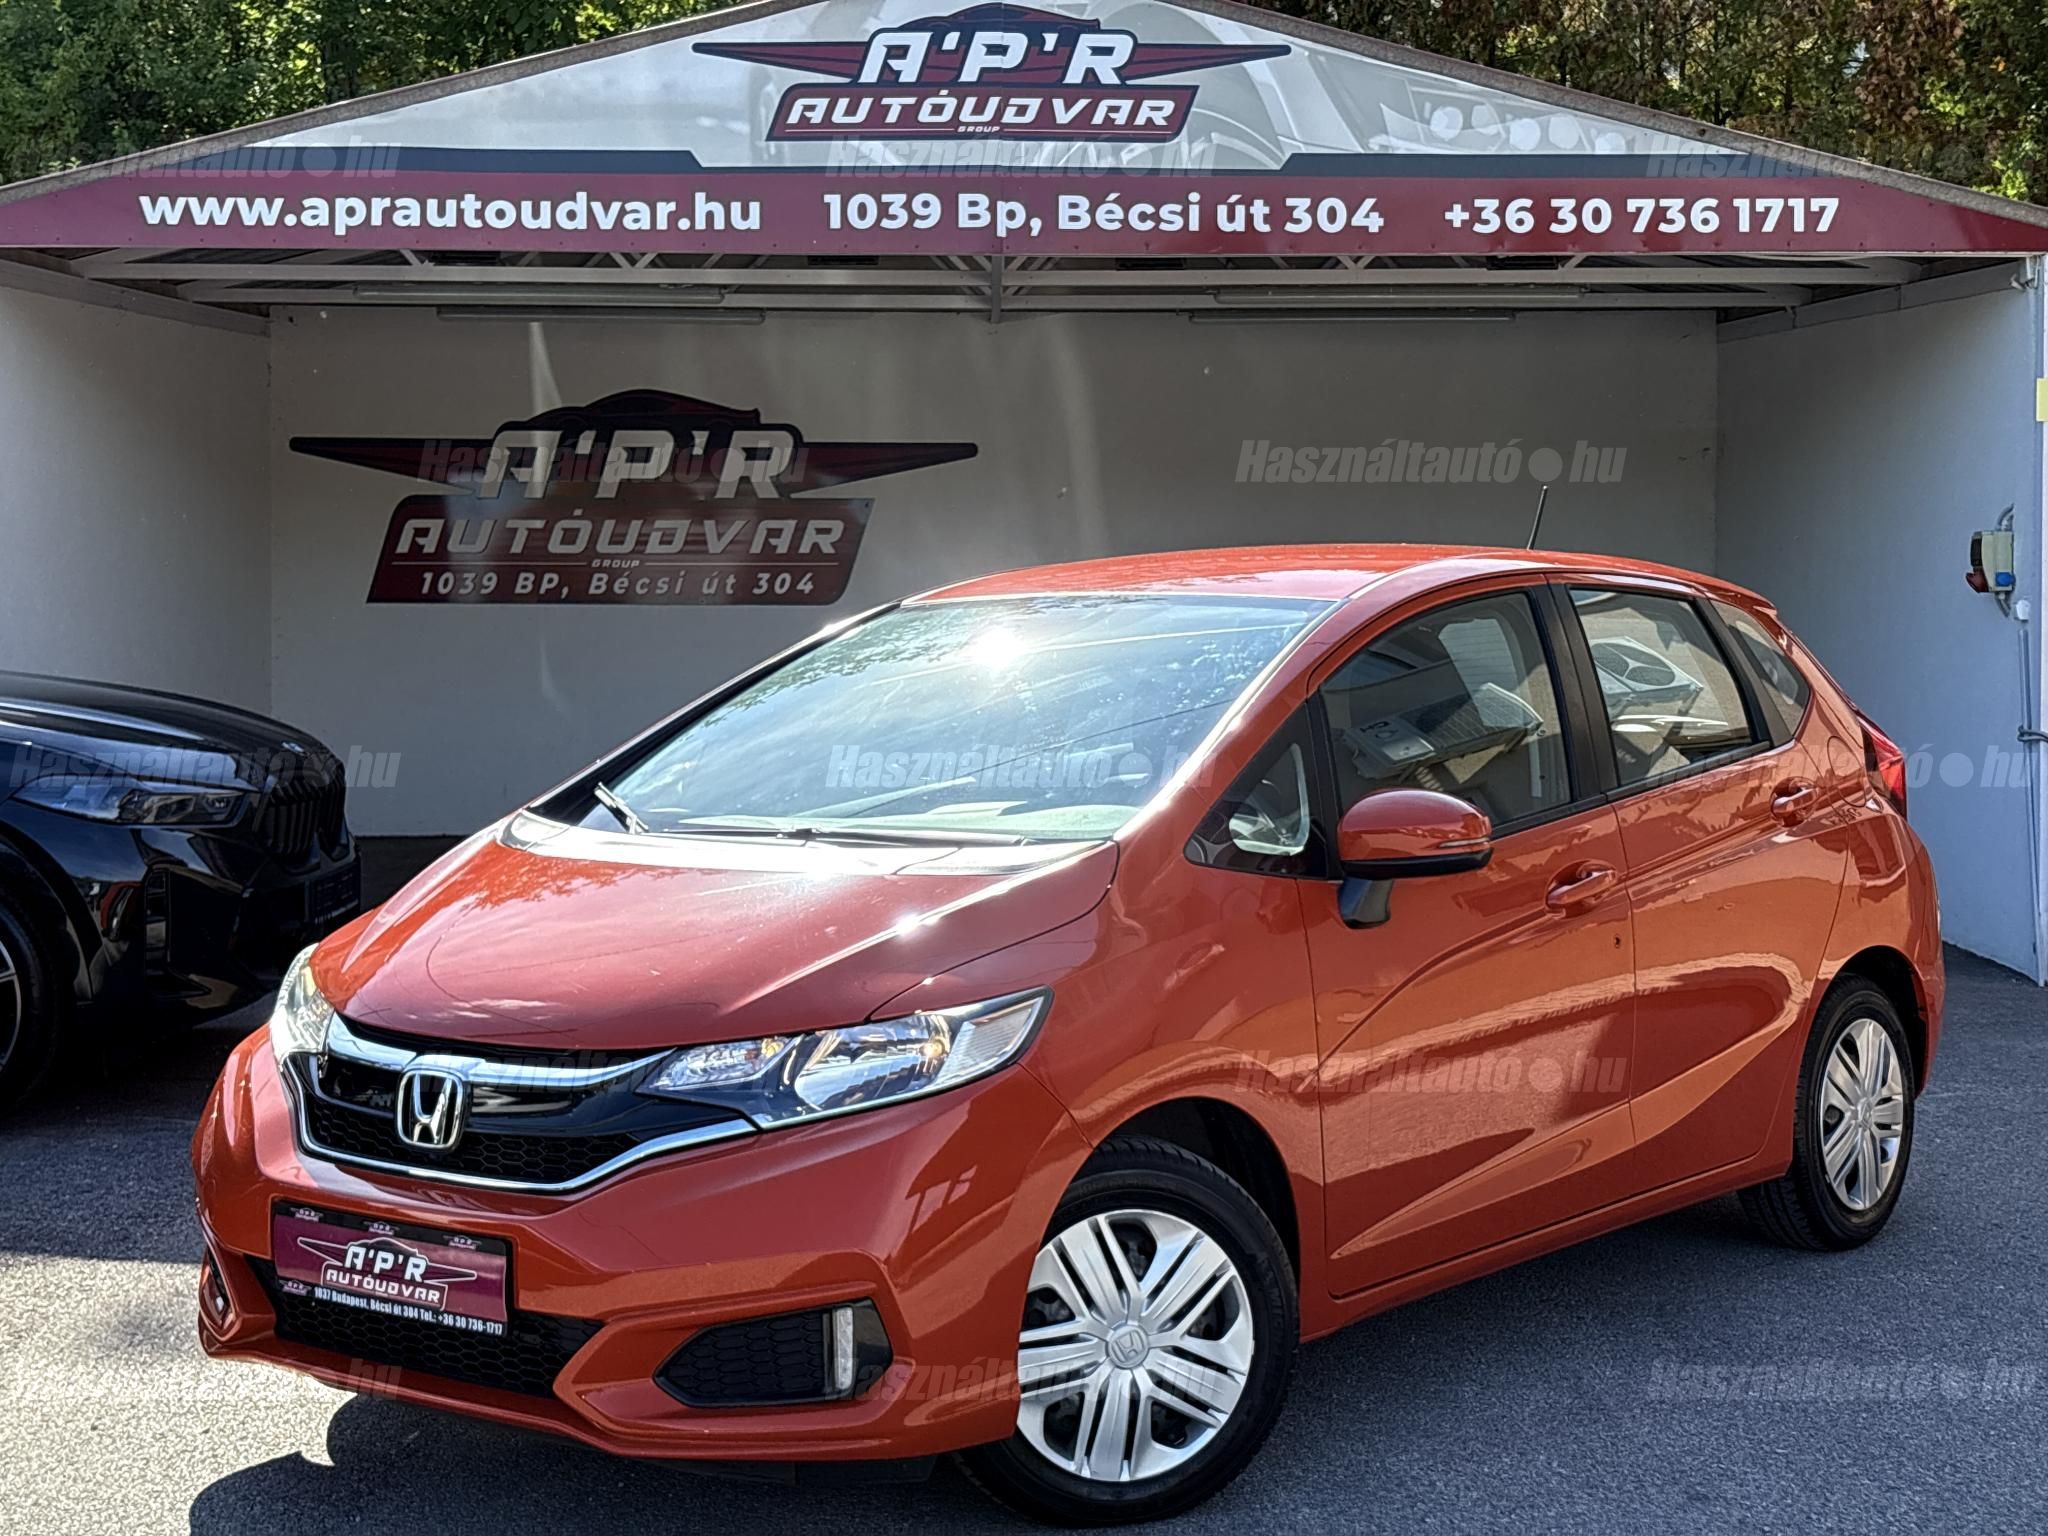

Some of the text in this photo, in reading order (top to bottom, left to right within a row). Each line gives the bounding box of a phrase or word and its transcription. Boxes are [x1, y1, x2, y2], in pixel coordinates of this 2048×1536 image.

[786, 89, 1177, 126] AUTÓUDVAR
[957, 125, 1001, 133] GROUP
[139, 190, 762, 236] www.aprautoudvar.hu
[822, 190, 1385, 237] 1039 Bp, Bécsi út 304
[1444, 198, 1840, 234] +36 30 736 1717
[395, 508, 846, 554] AUTÓUDVAR
[591, 558, 641, 568] GROUP
[420, 571, 815, 600] 1039 BP, Bécsi út 304
[326, 1268, 441, 1303] AUTÓUDVAR
[403, 1305, 418, 1319] 304
[438, 1312, 454, 1325] +36
[455, 1316, 466, 1328] 30
